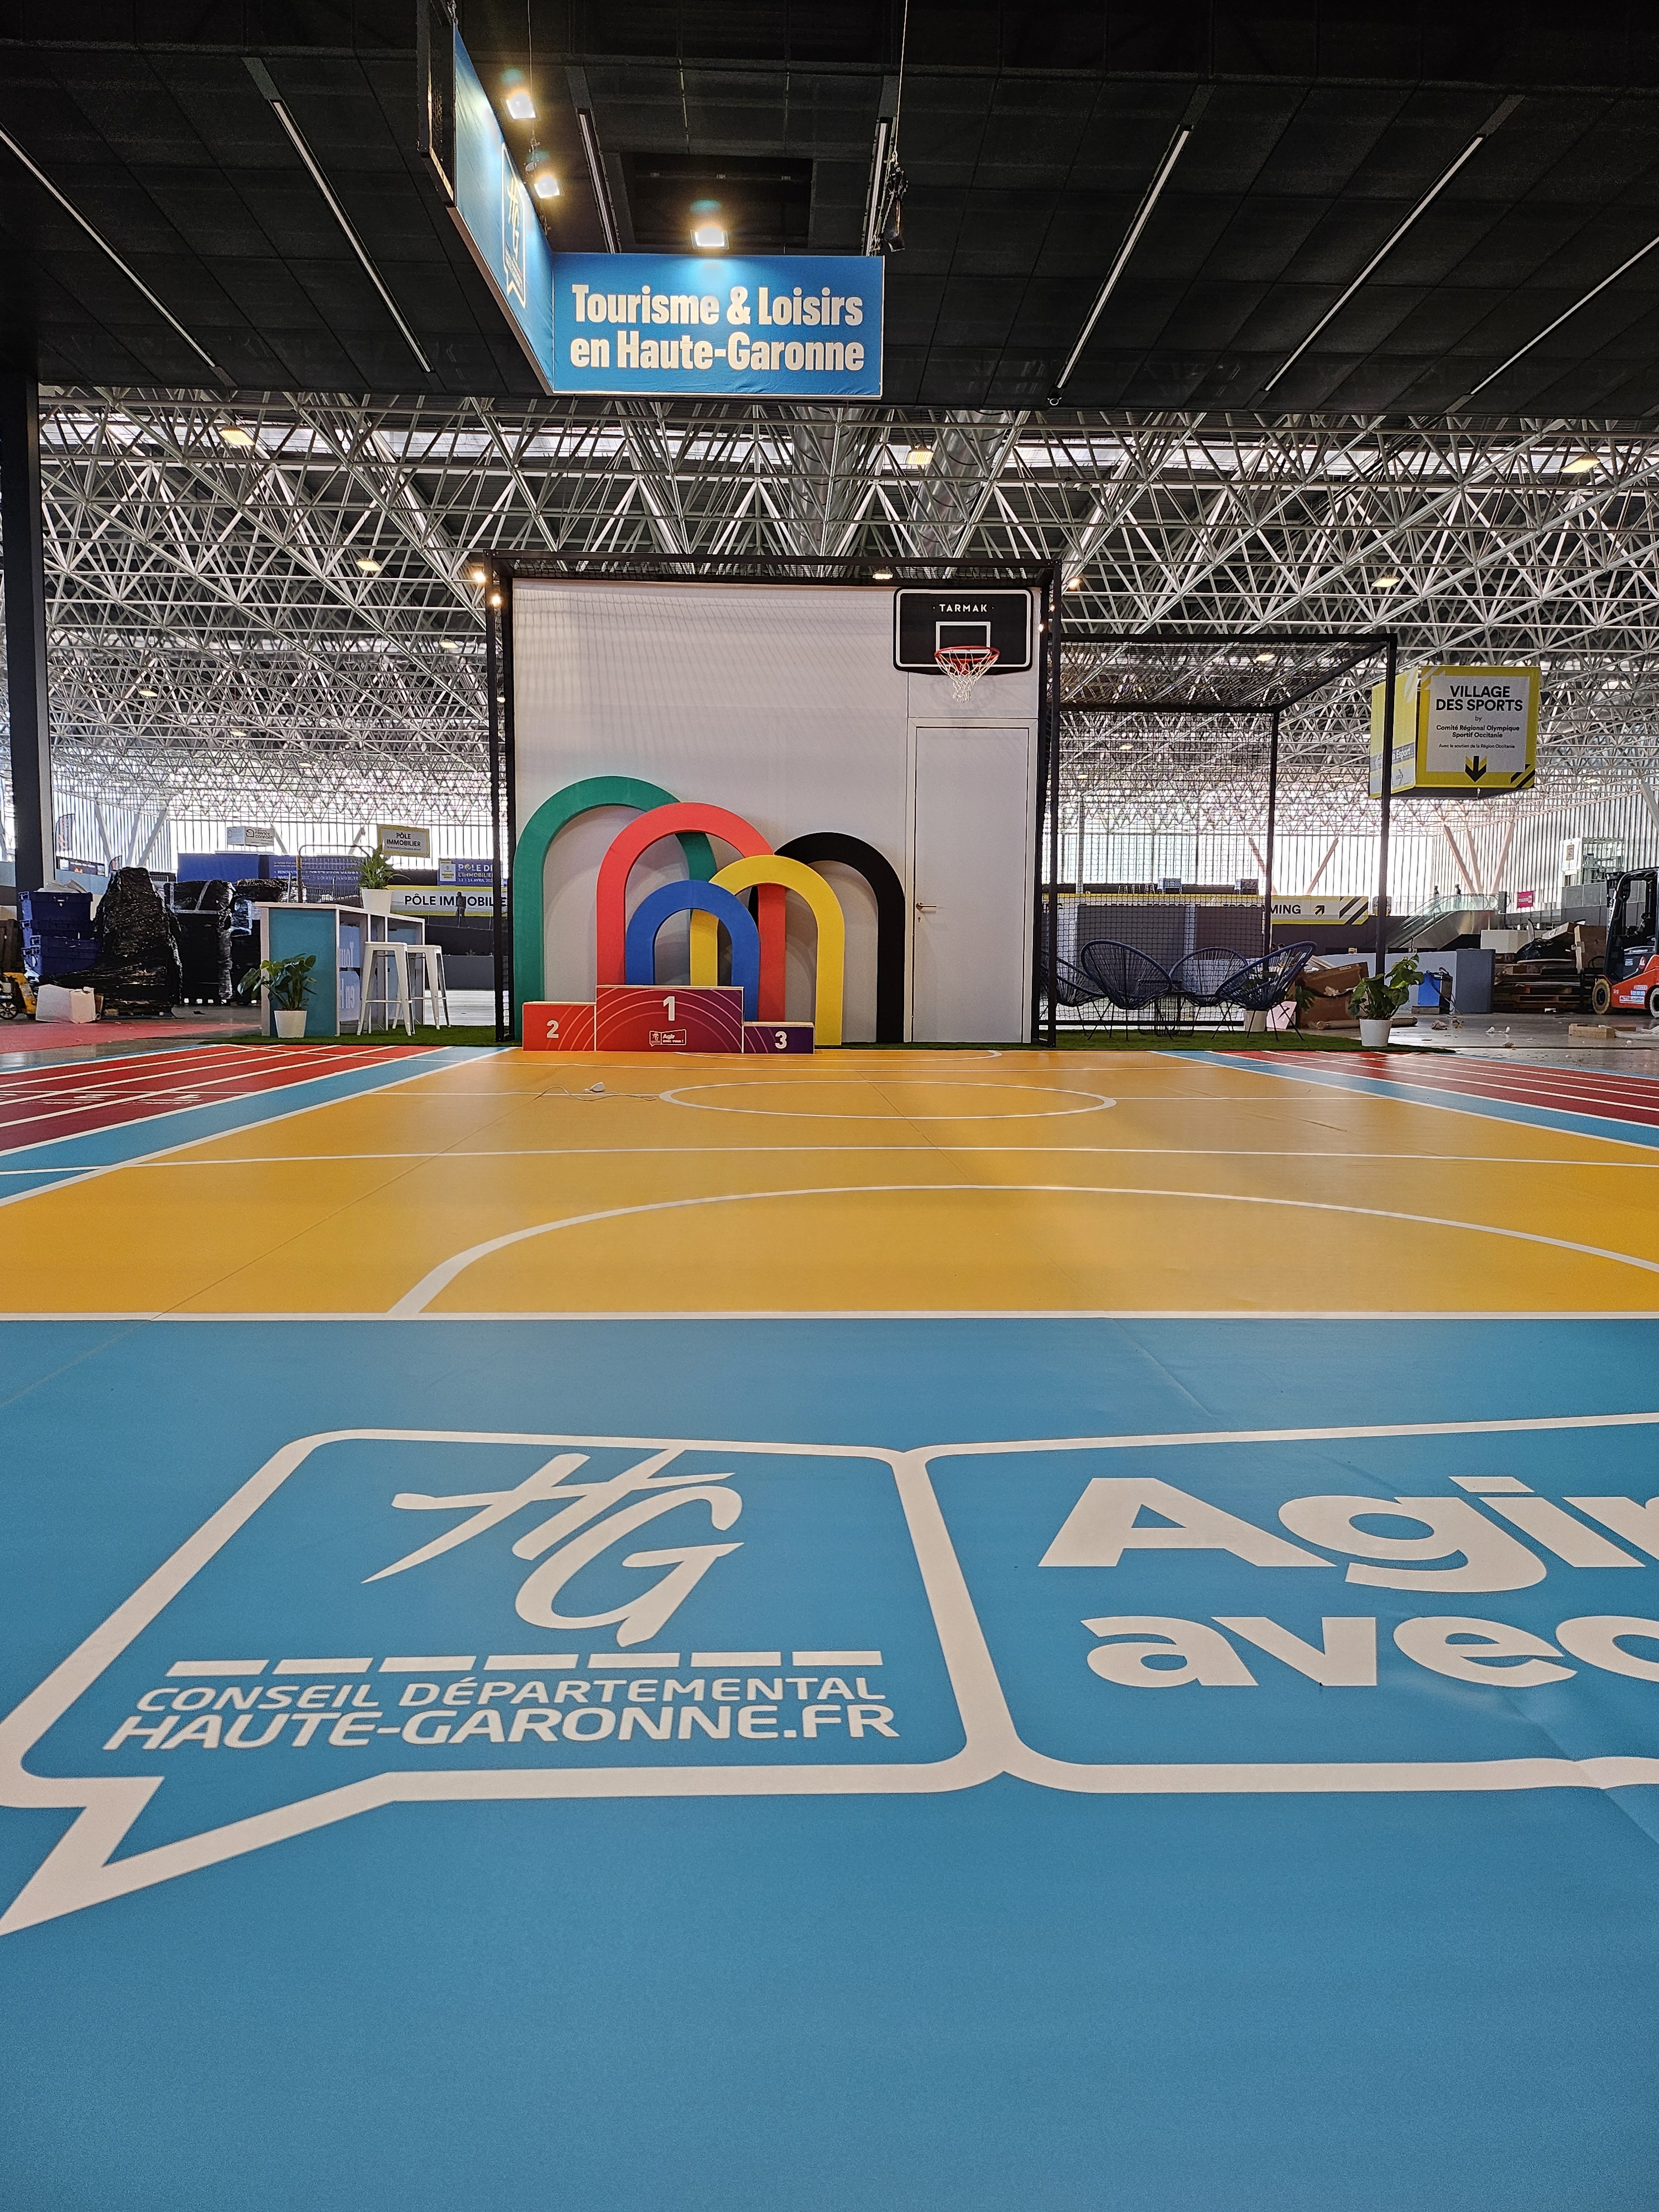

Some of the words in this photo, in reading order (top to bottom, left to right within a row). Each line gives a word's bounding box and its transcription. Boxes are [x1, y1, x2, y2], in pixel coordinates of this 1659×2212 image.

[571, 284, 719, 325] Tourisme
[727, 286, 751, 325] &
[758, 287, 863, 326] Loisirs
[570, 336, 610, 368] en
[617, 330, 864, 371] Haute-Garonne
[939, 603, 988, 613] TARMAK
[1449, 685, 1510, 698] VILLAGE
[1436, 698, 1463, 711] DES
[1466, 698, 1523, 712] SPORTS
[404, 893, 436, 905] PÔLE
[662, 996, 675, 1021] 1
[546, 1020, 559, 1039] 2
[775, 1031, 787, 1049] 3
[136, 1683, 379, 1712] CONSEIL
[398, 1676, 886, 1707] DÉPARTEMENTAL
[102, 1703, 900, 1751] HAUTE-GARONNE.FR
